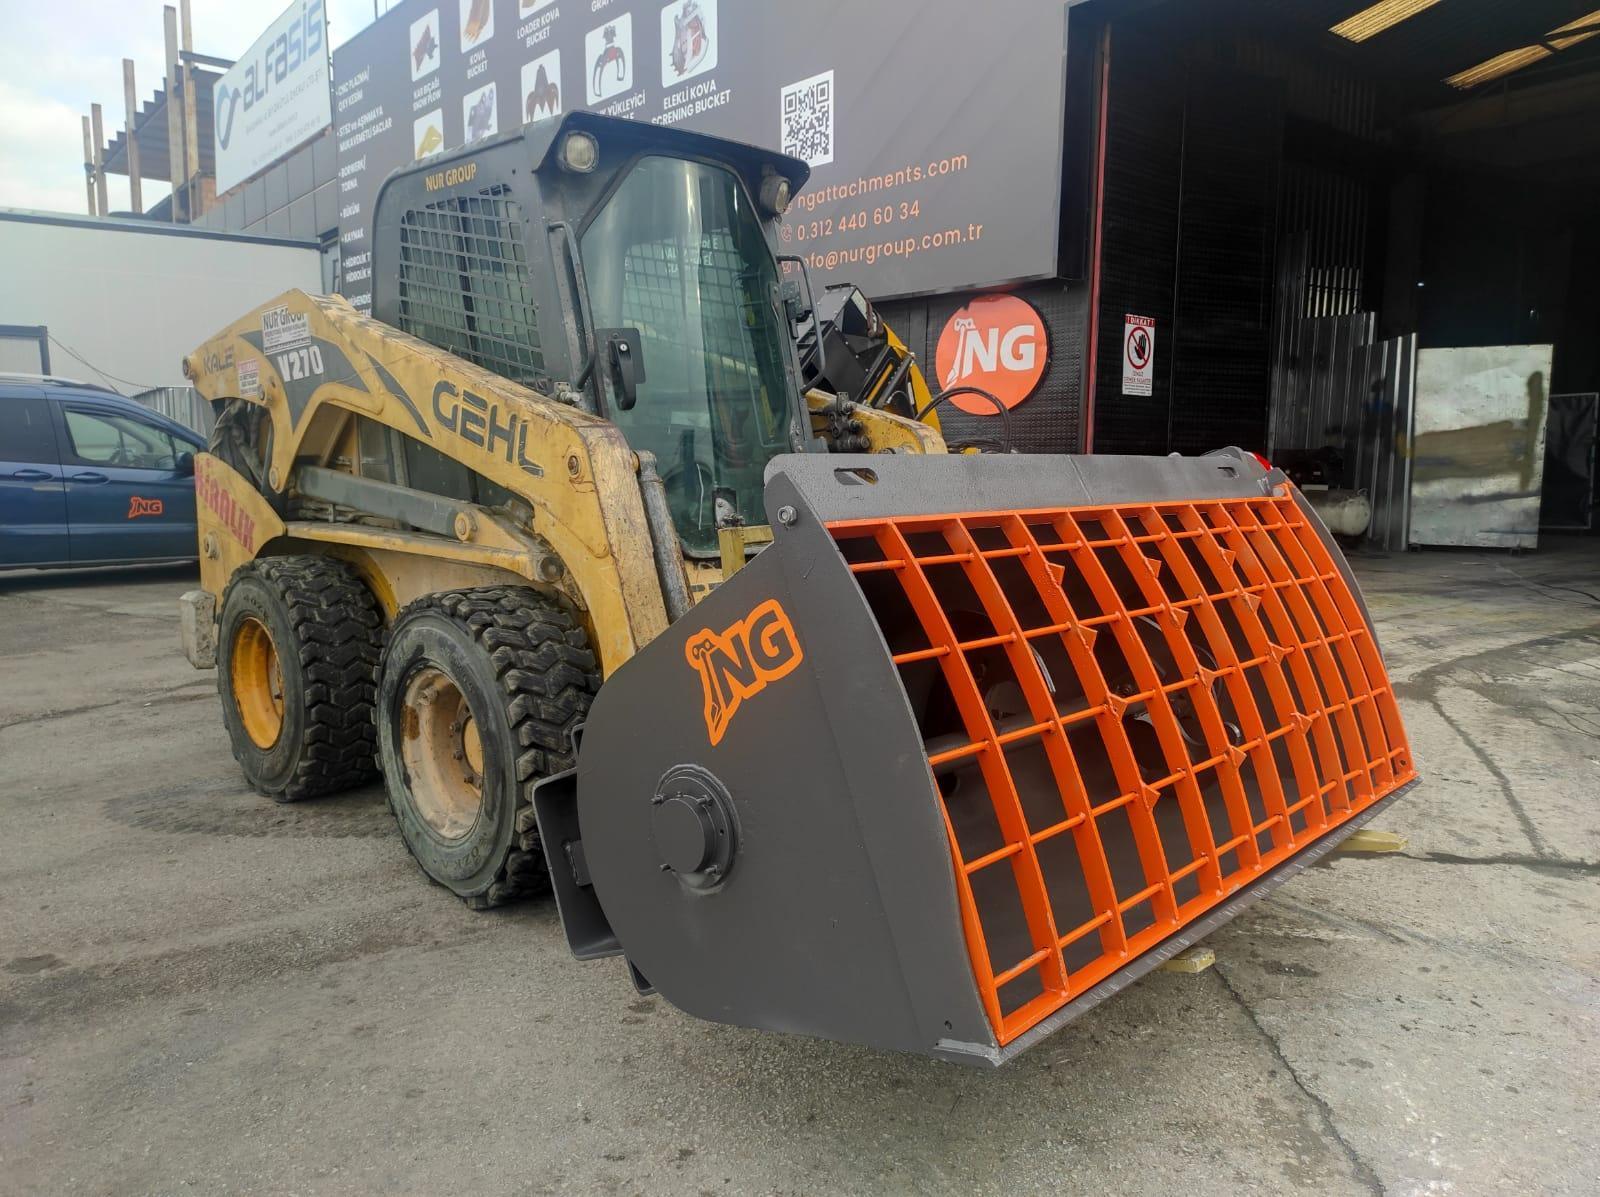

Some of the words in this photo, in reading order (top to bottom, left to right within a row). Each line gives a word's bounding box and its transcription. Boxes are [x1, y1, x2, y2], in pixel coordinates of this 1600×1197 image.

[516, 18, 541, 40] LOADER
[541, 7, 560, 26] KOVA
[526, 26, 551, 48] BUCKET
[467, 60, 488, 79] BUCKET
[470, 49, 486, 66] KOVA
[607, 89, 646, 117] YÜKLEYİCİ
[651, 103, 694, 126] SCRENING
[695, 89, 731, 114] BUCKET
[663, 85, 689, 110] ELEKLİ
[690, 79, 717, 101] KOVA
[341, 178, 358, 192] TORNA
[425, 172, 445, 192] NUR
[446, 162, 477, 187] GROUP
[797, 153, 968, 211] ngattachments.com
[797, 219, 833, 241] 0.312
[838, 211, 867, 233] 440
[873, 205, 893, 225] 60
[899, 199, 920, 221] 34
[344, 228, 364, 243] KAYNAK
[797, 223, 984, 273] info@nurgroup.com.tr
[263, 310, 279, 331] NUR
[277, 345, 324, 383] V270
[432, 379, 545, 479] GEHL
